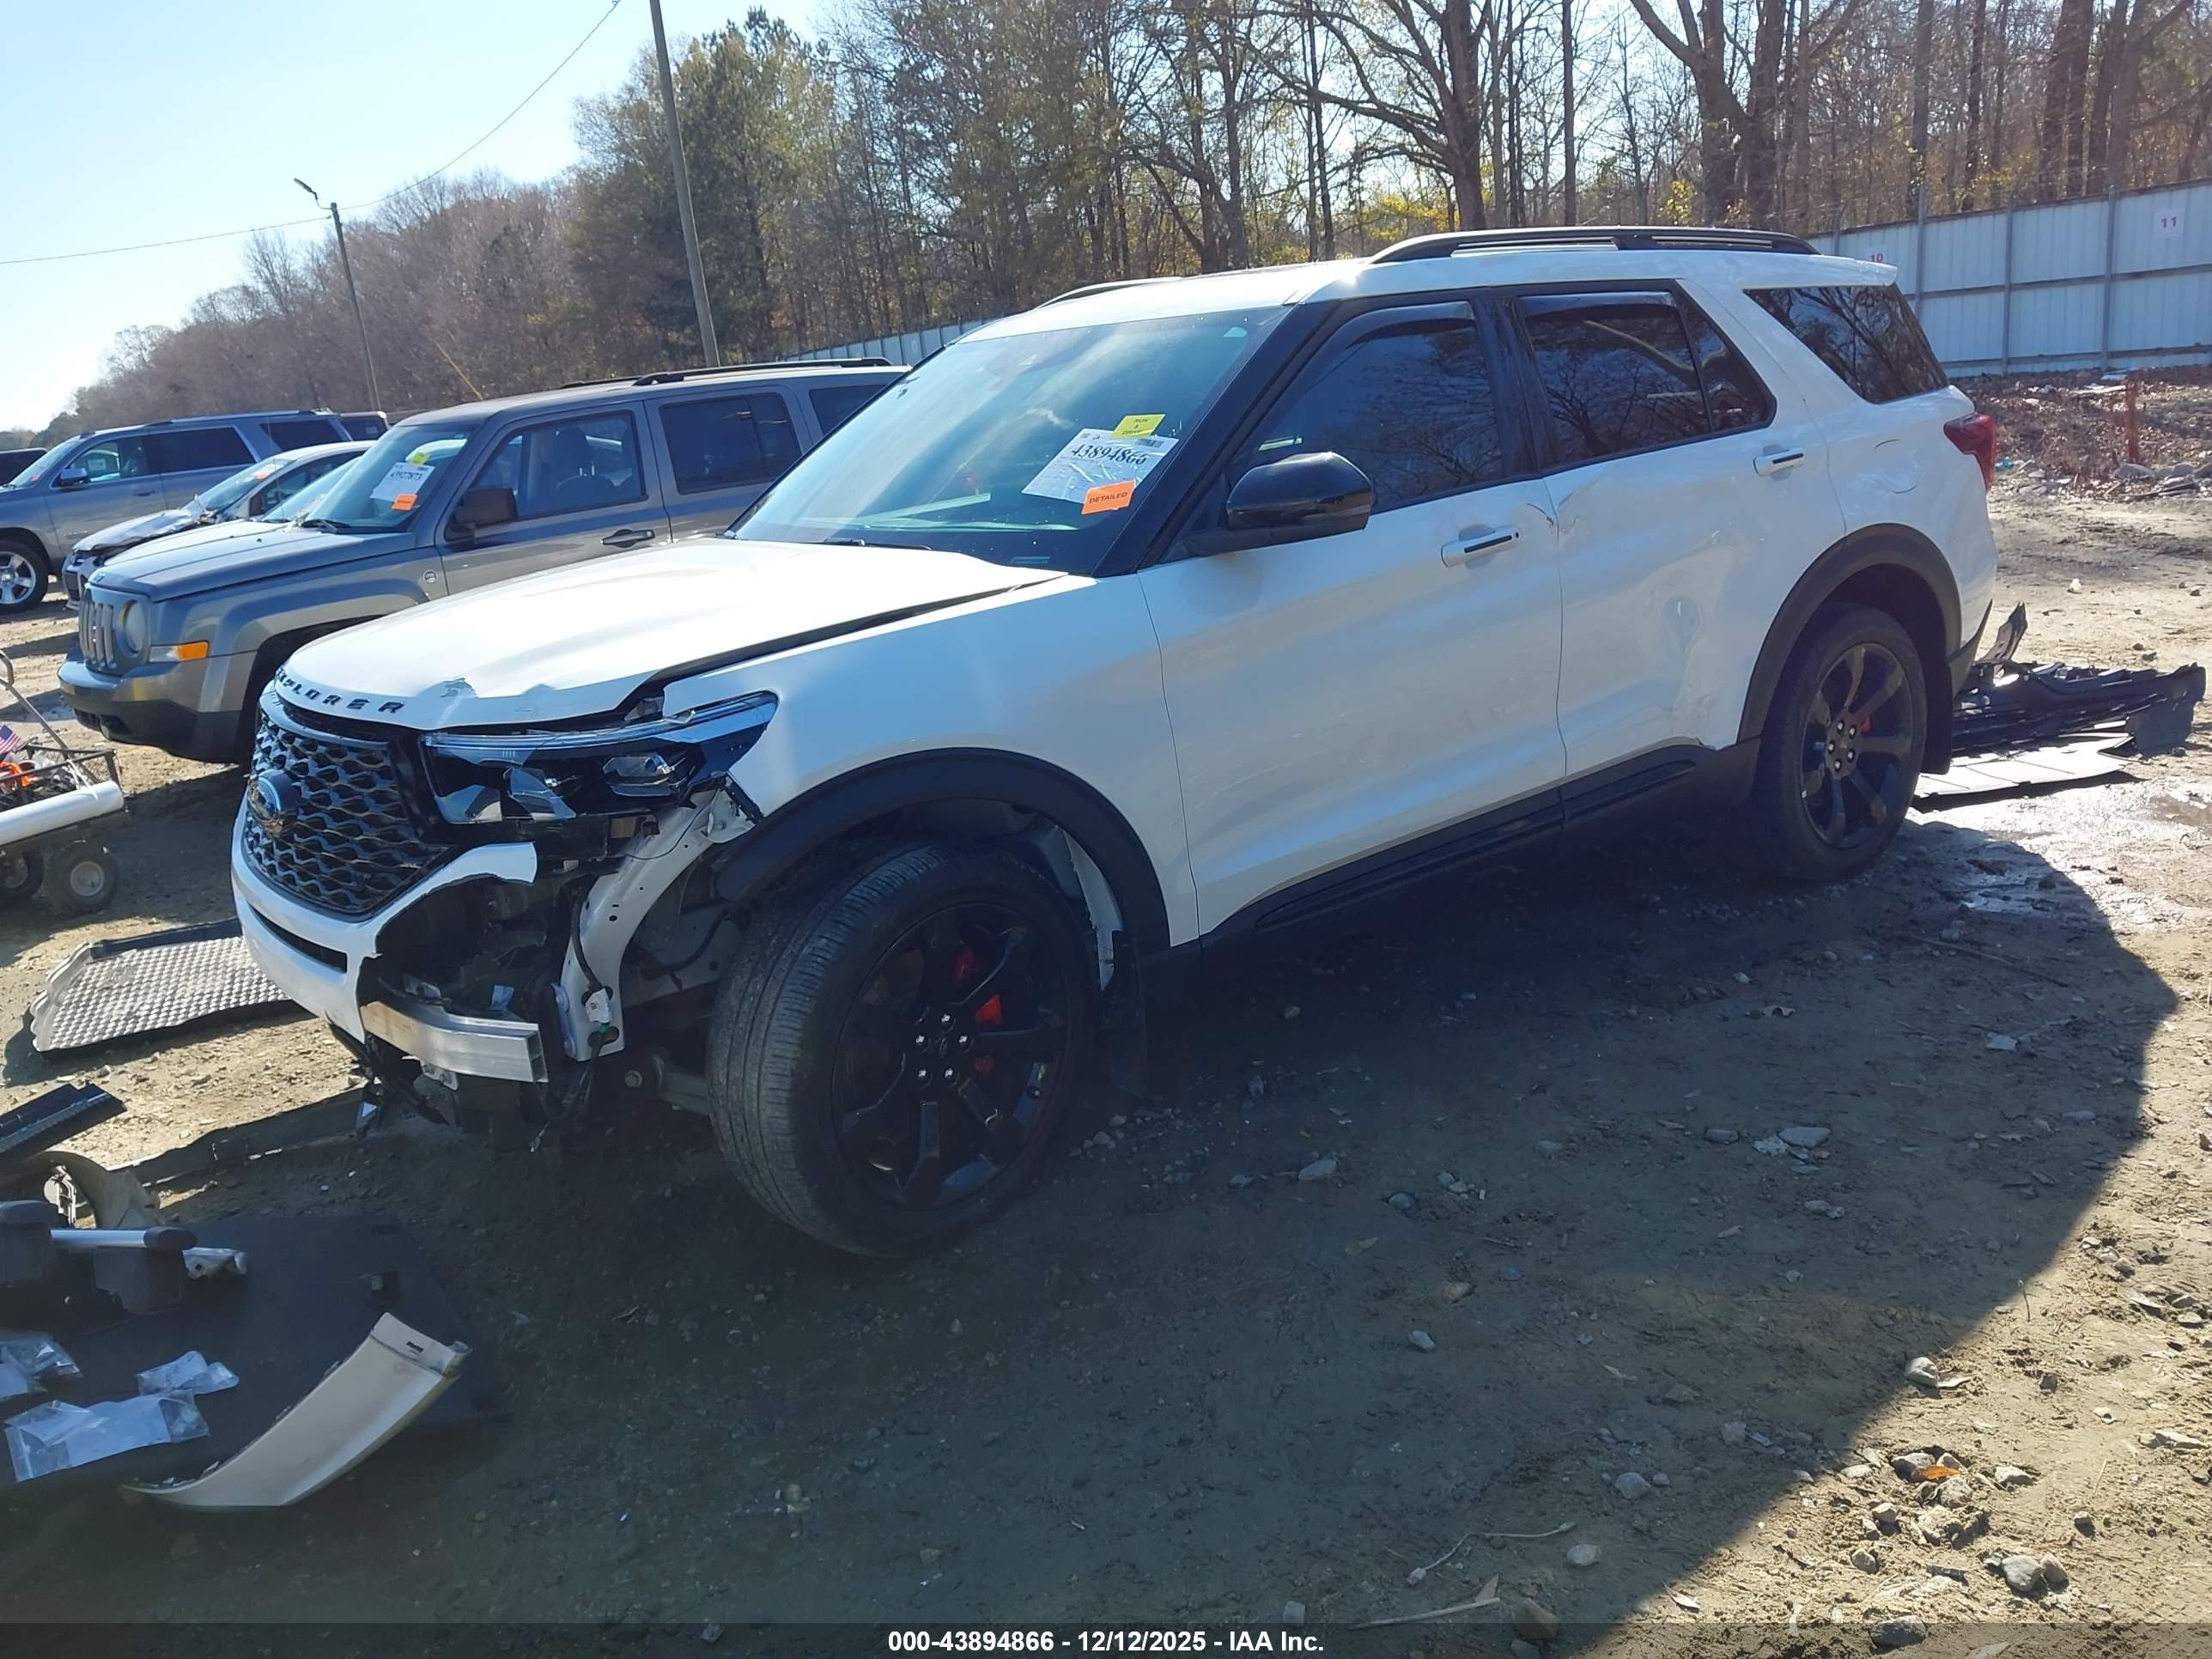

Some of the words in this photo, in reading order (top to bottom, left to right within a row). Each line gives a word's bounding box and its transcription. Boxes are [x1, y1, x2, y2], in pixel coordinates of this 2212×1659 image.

[2160, 216, 2178, 228] 11
[1871, 252, 1883, 263] 10
[1072, 443, 1148, 465] 43894866
[1089, 492, 1127, 503] DETAILED
